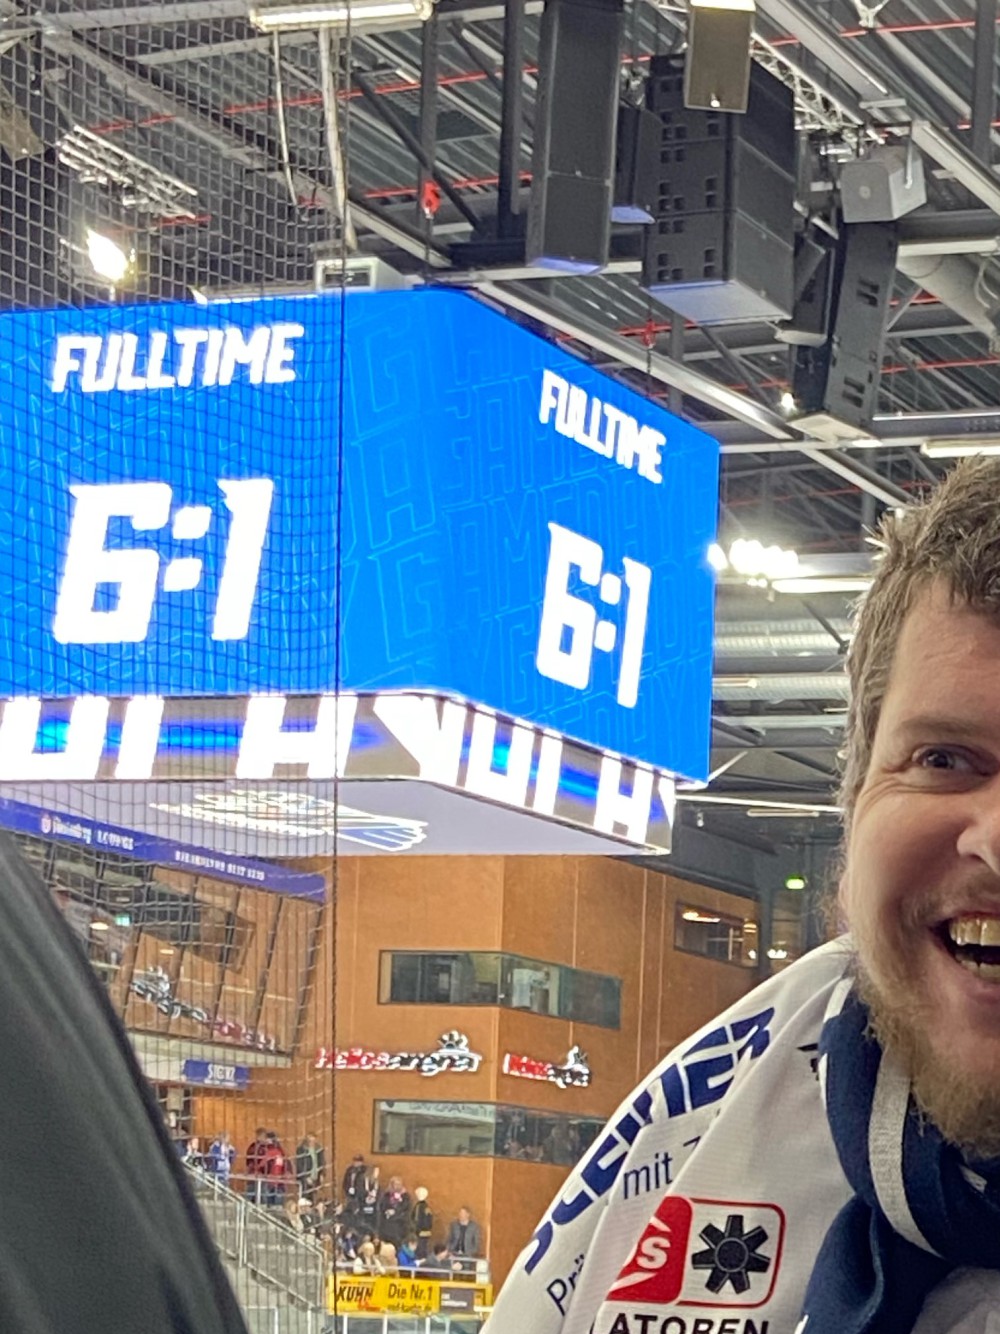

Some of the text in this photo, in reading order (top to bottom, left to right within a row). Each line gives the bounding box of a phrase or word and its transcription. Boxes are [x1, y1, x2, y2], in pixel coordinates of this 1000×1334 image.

[52, 324, 305, 392] FULLTIME
[538, 368, 667, 484] FULLTIME
[53, 477, 274, 644] 6:1
[536, 521, 652, 709] 6:1
[622, 1152, 674, 1200] mit
[388, 1283, 407, 1300] Die
